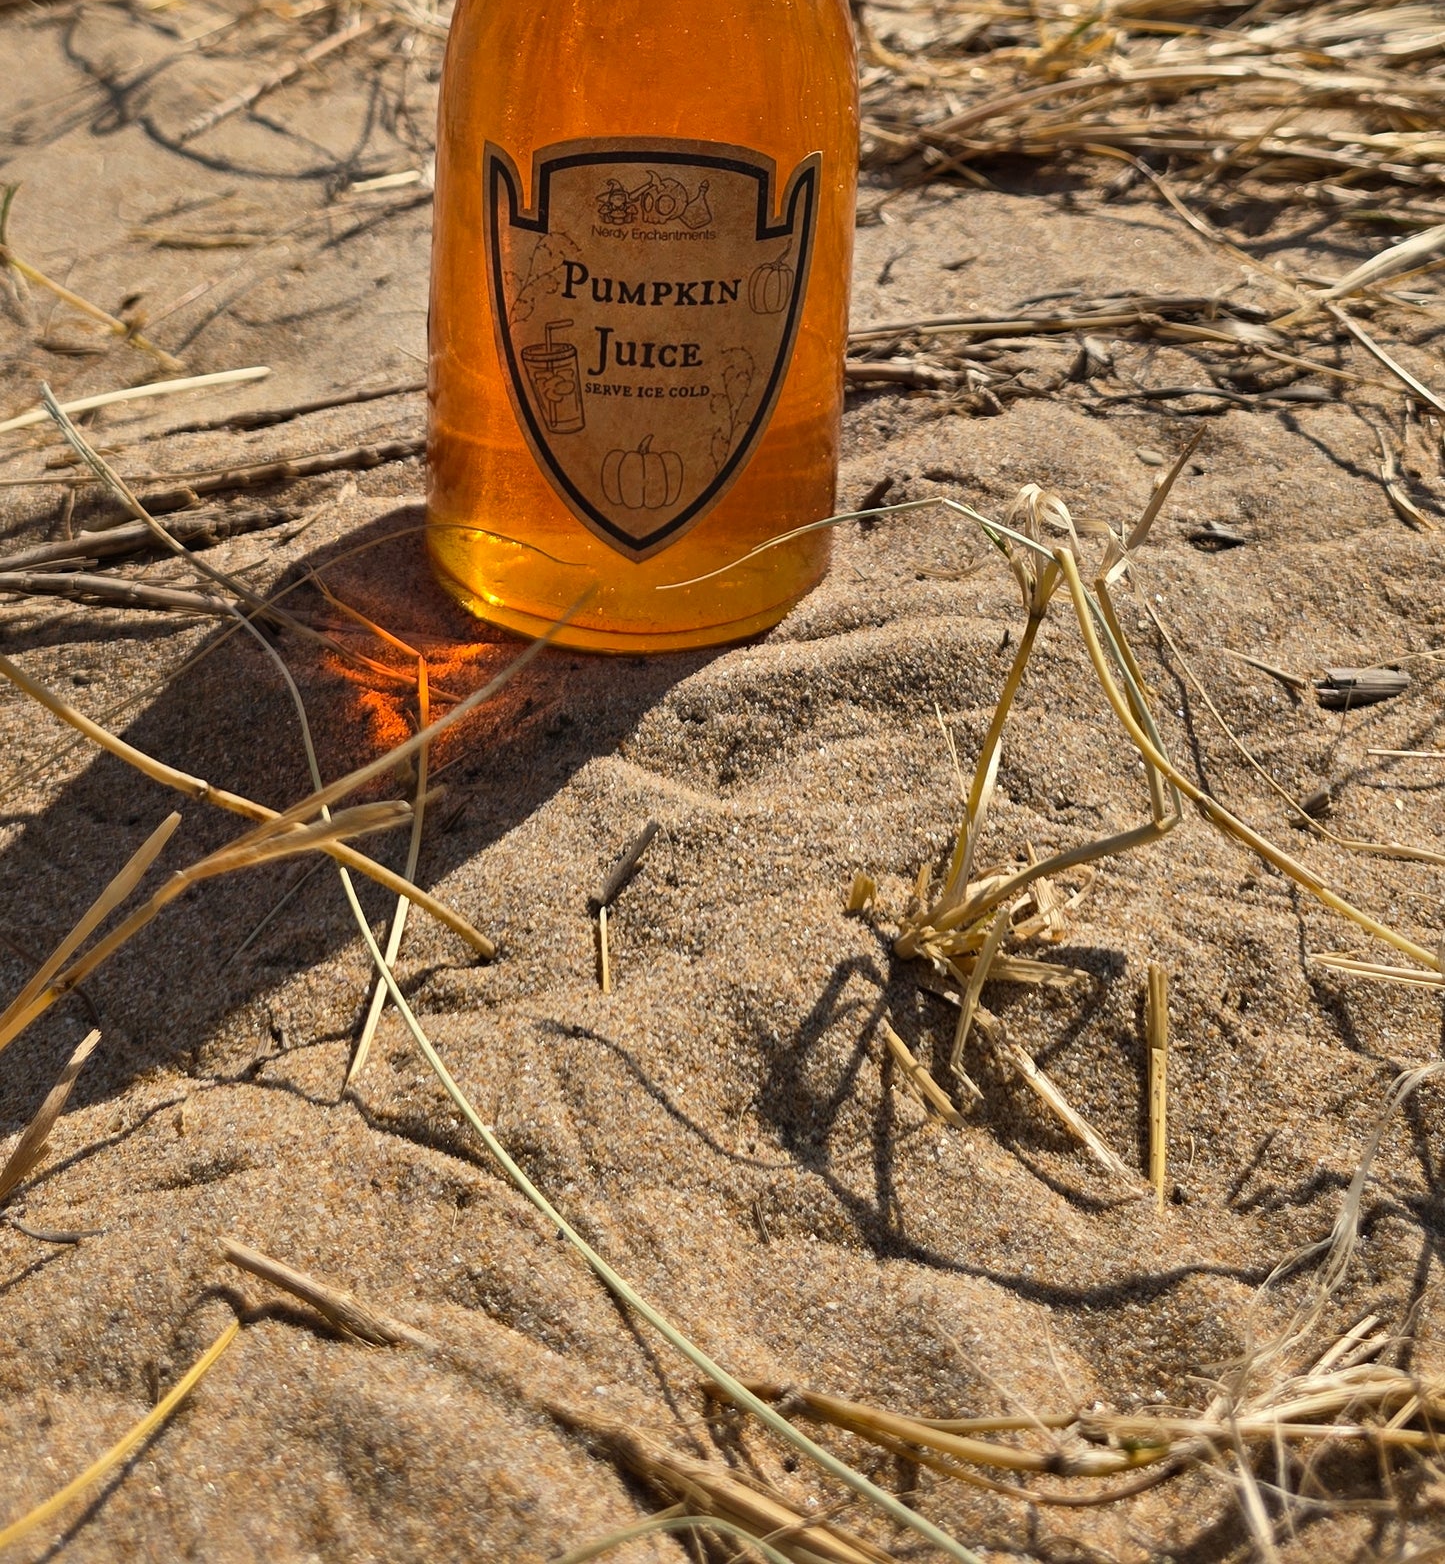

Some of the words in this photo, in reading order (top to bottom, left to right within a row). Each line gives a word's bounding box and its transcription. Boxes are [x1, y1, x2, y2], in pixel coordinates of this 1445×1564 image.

[591, 225, 628, 241] Nerdy
[631, 226, 716, 242] Enchantments
[561, 259, 742, 306] PUMPKIN
[587, 326, 703, 375] JUICE
[585, 382, 632, 397] SERVE
[637, 385, 664, 398] ICE
[669, 385, 710, 398] COLD
